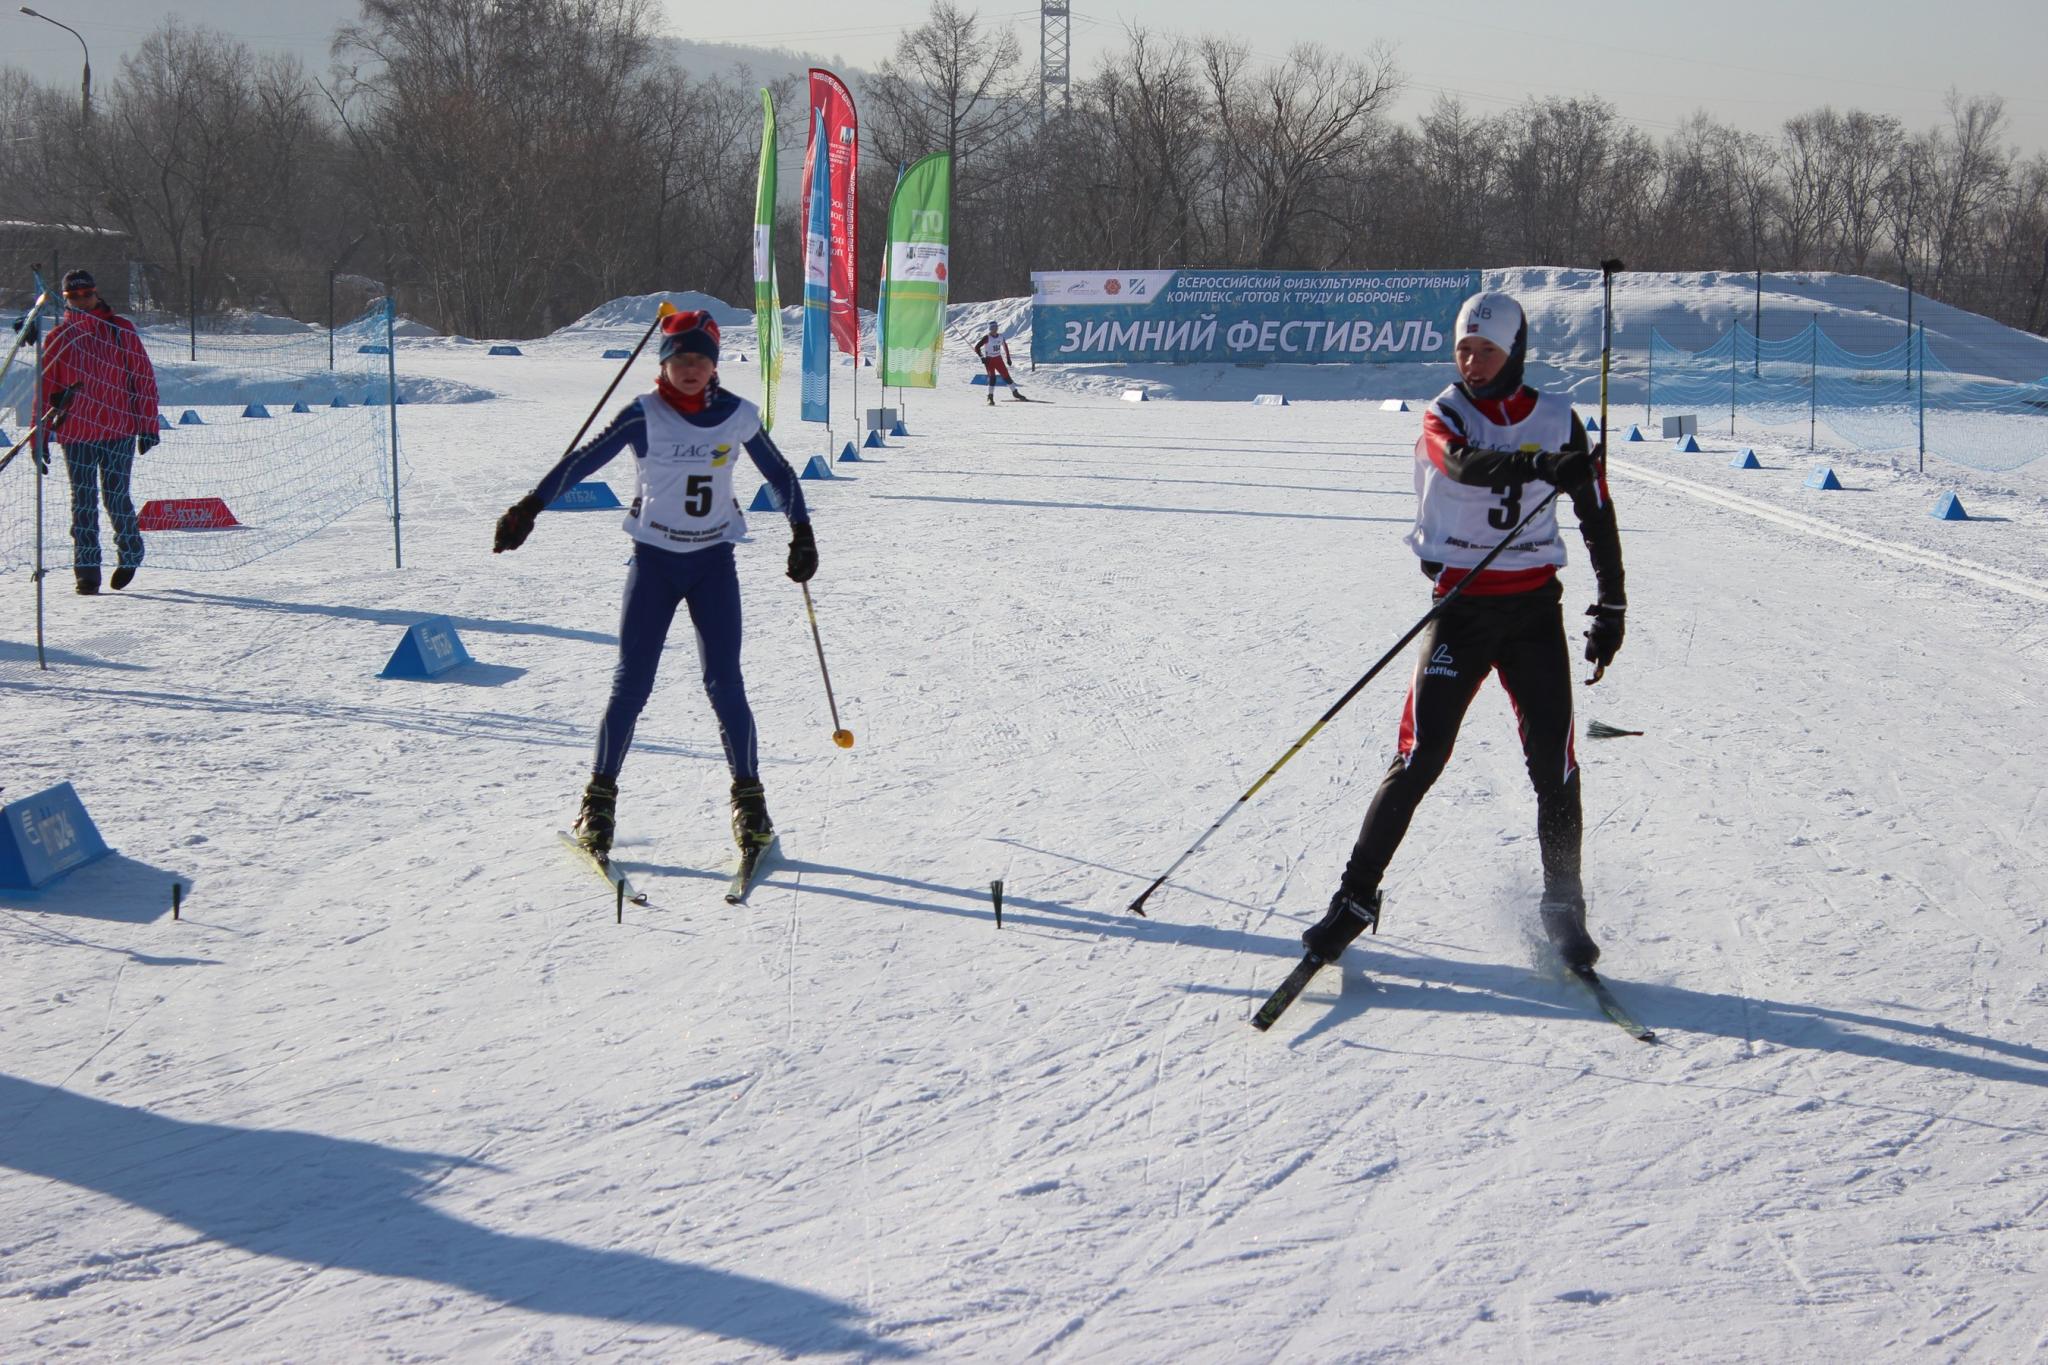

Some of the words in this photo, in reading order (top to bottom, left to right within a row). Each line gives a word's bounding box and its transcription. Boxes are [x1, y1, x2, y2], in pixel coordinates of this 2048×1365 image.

[1166, 291, 1233, 303] КОМПЛЕКС
[1235, 291, 1280, 303] «ГОТОВ
[1282, 292, 1293, 303] К
[1294, 292, 1333, 305] ТРУДУ
[1335, 292, 1344, 303] И
[1347, 291, 1411, 303] ОБОРОНЕ»
[1177, 275, 1281, 289] ВСЕРОССИЙСКИЙ
[1284, 274, 1470, 290] ФИЗКУЛЬТУРНО-СПОРТИВНЫЙ
[1059, 313, 1218, 352] ЗИМНИЙ
[1226, 319, 1443, 352] ФЕСТИВАЛЬ
[685, 474, 713, 518] 5
[1488, 479, 1523, 530] 3
